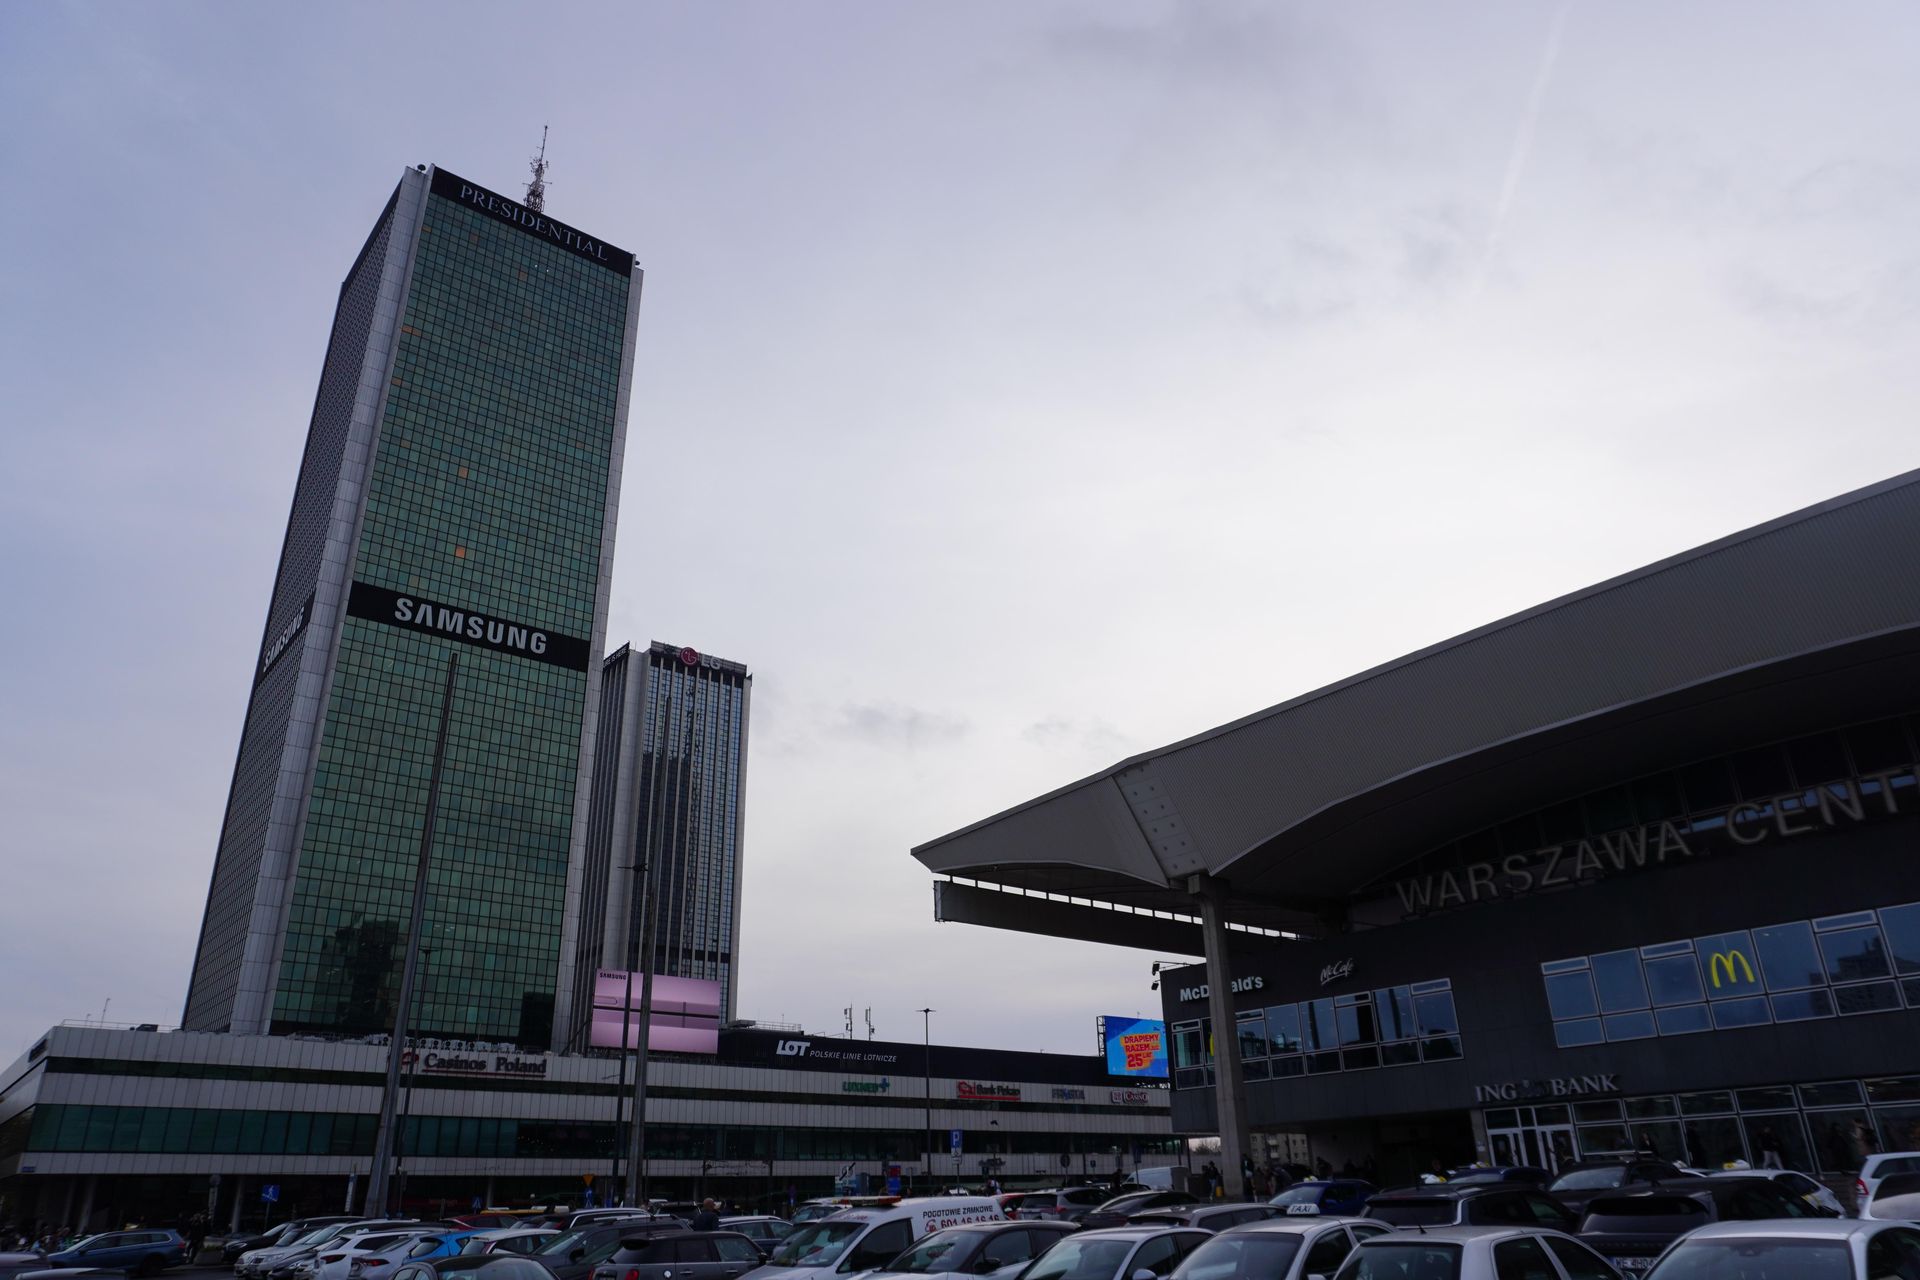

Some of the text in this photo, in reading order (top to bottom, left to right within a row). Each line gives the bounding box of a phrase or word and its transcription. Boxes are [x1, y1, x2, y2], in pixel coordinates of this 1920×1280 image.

[460, 184, 608, 261] PRESIDENTIAL
[394, 597, 548, 655] SAMSUNG
[263, 606, 305, 673] SAMSUNG
[701, 654, 721, 670] LG
[1395, 765, 1920, 915] WARSZAWA CENT
[599, 972, 627, 980] SAMSUNG
[1179, 976, 1265, 1002] McDald's
[1124, 1034, 1159, 1044] DRAPIEMY
[776, 1040, 897, 1063] LOT POLSKIE LINIE LOTNICZE
[1126, 1044, 1150, 1053] RAZEM
[424, 1053, 547, 1073] Casinos Poland
[1127, 1054, 1143, 1068] 25
[976, 1084, 996, 1095] Bank
[1474, 1073, 1619, 1102] ING BANK
[923, 1205, 993, 1218] POGOTOWIE ZAMKOWE
[1291, 1205, 1311, 1213] TAXI
